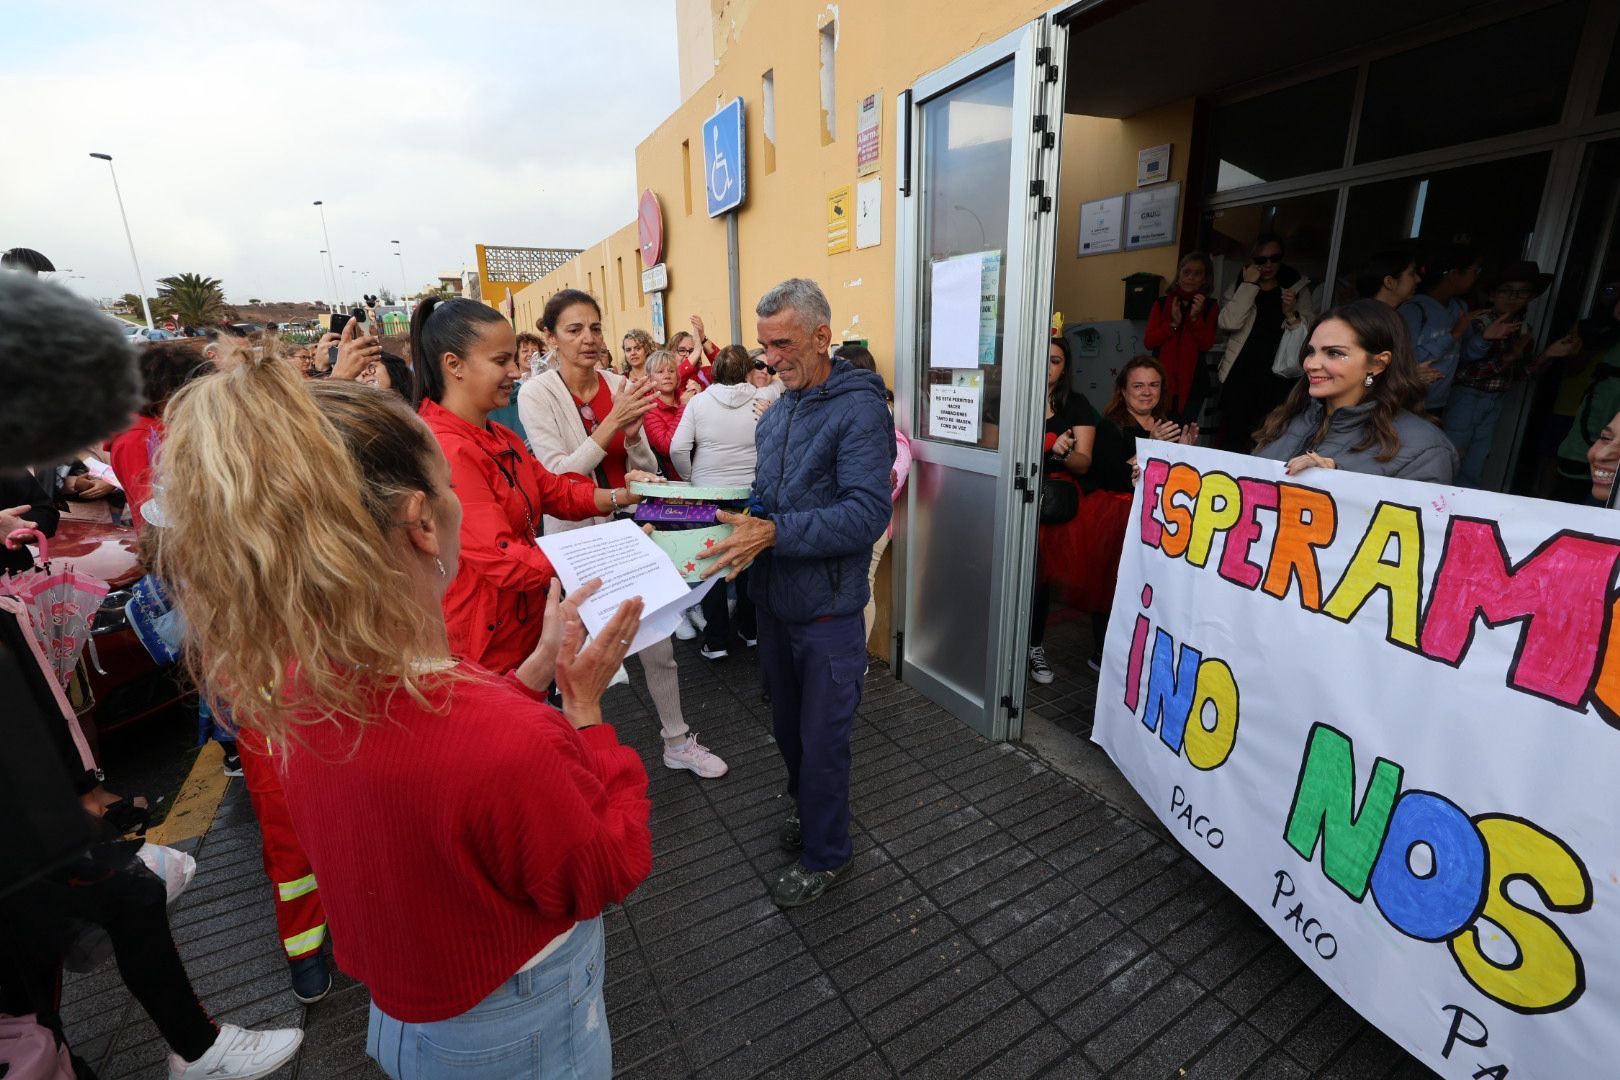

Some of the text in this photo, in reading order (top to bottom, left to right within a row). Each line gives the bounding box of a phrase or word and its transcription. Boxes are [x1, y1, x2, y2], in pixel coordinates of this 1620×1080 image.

[1140, 457, 1620, 730] ESPERAM
[1170, 785, 1225, 850] PACO
[1273, 869, 1338, 961] PACO
[1284, 722, 1594, 1016] NOS
